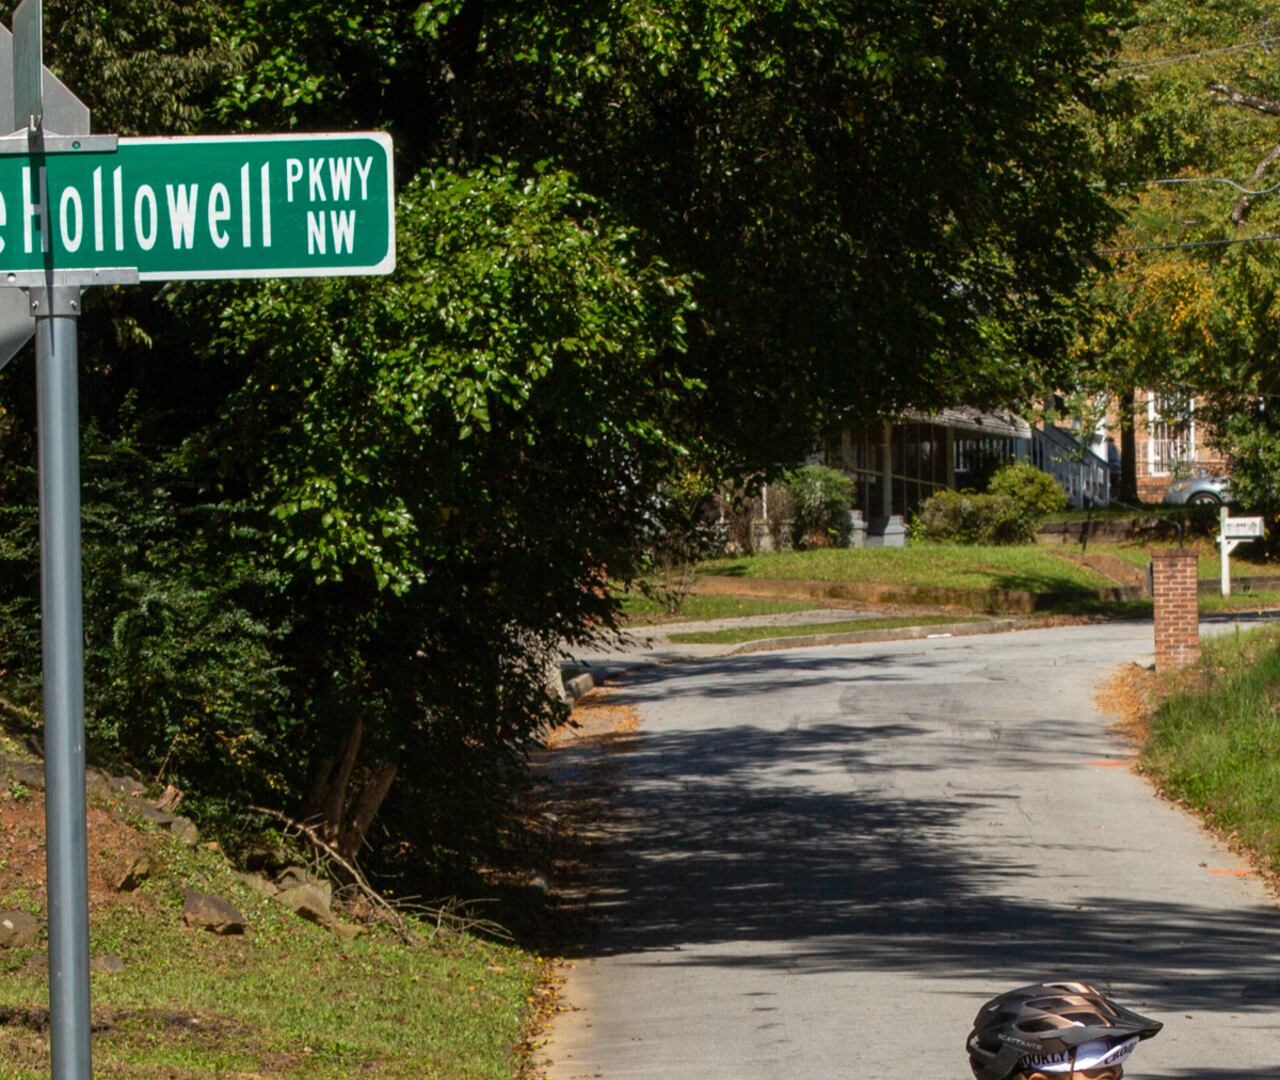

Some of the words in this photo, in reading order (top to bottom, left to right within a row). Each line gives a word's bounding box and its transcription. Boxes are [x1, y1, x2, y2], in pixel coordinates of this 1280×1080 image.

[22, 161, 272, 254] Hollowell
[286, 156, 374, 203] PKWY
[307, 209, 356, 255] NW
